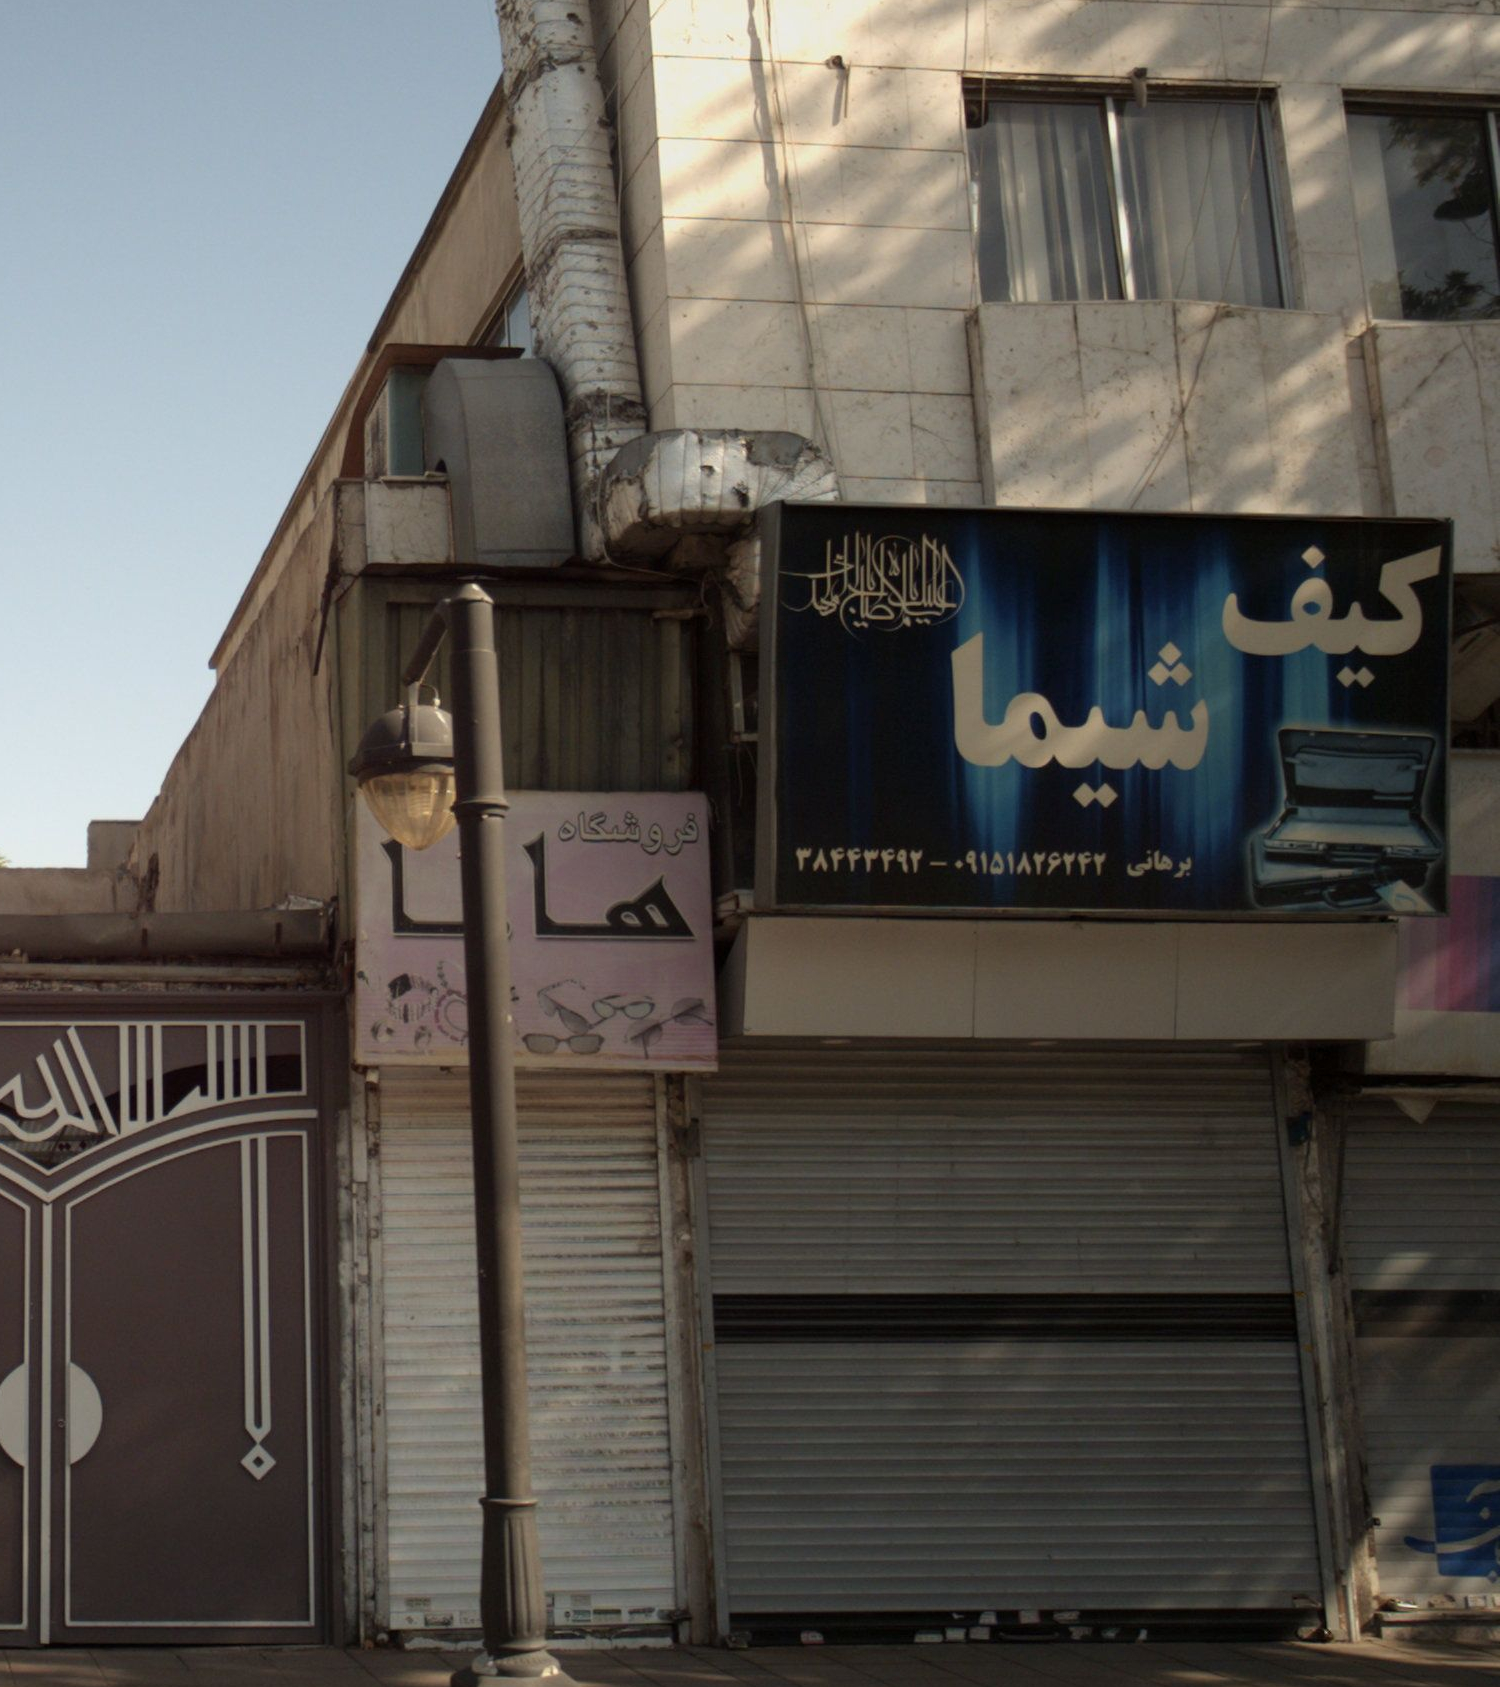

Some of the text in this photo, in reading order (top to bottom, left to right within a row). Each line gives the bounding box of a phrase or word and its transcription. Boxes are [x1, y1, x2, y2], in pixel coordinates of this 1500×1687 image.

[1222, 545, 1442, 688] کیف
[951, 633, 1209, 808] شیما
[558, 811, 698, 855] فروشگاه
[1126, 849, 1192, 878] برهانی
